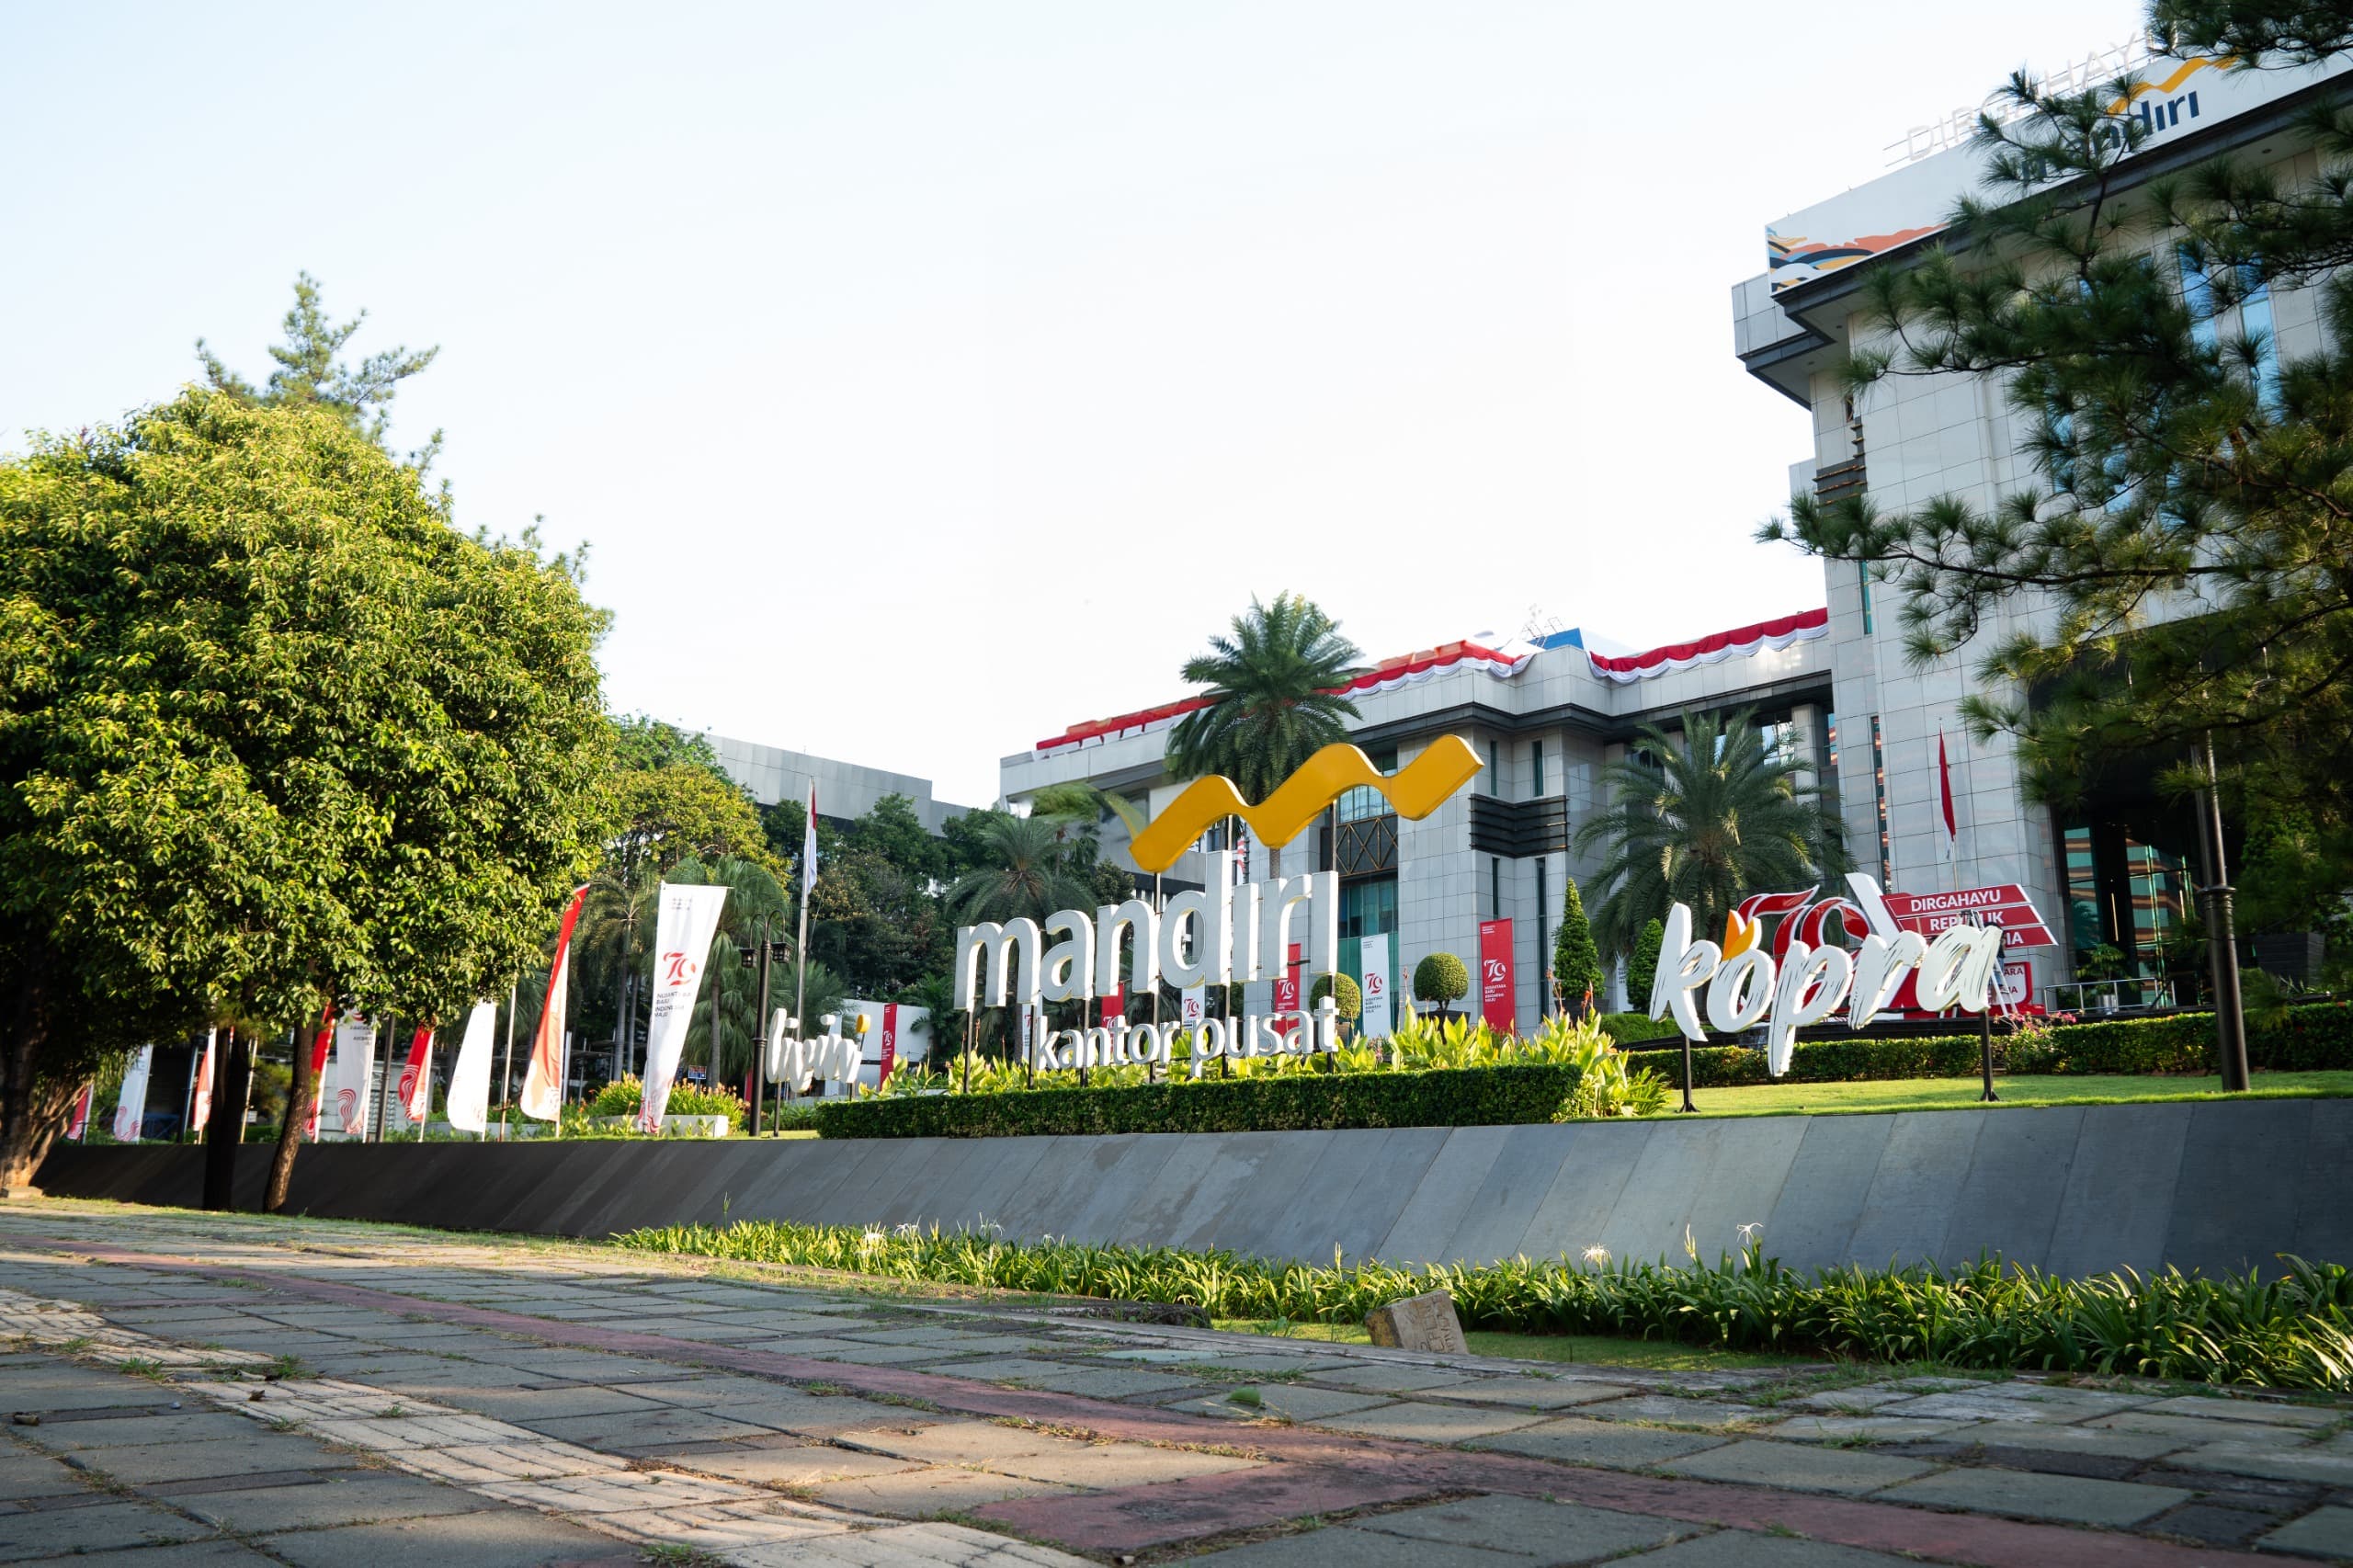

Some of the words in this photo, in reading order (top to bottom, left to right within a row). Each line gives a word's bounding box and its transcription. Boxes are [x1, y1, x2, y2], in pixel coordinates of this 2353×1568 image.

[1906, 17, 2178, 162] DIRGHAYU
[954, 850, 1339, 1011] mandiri
[1911, 889, 2001, 913] DIRGAHAYU
[1035, 1013, 1181, 1071] kantor
[1191, 995, 1339, 1078] pusat
[1649, 902, 2003, 1077] kopra
